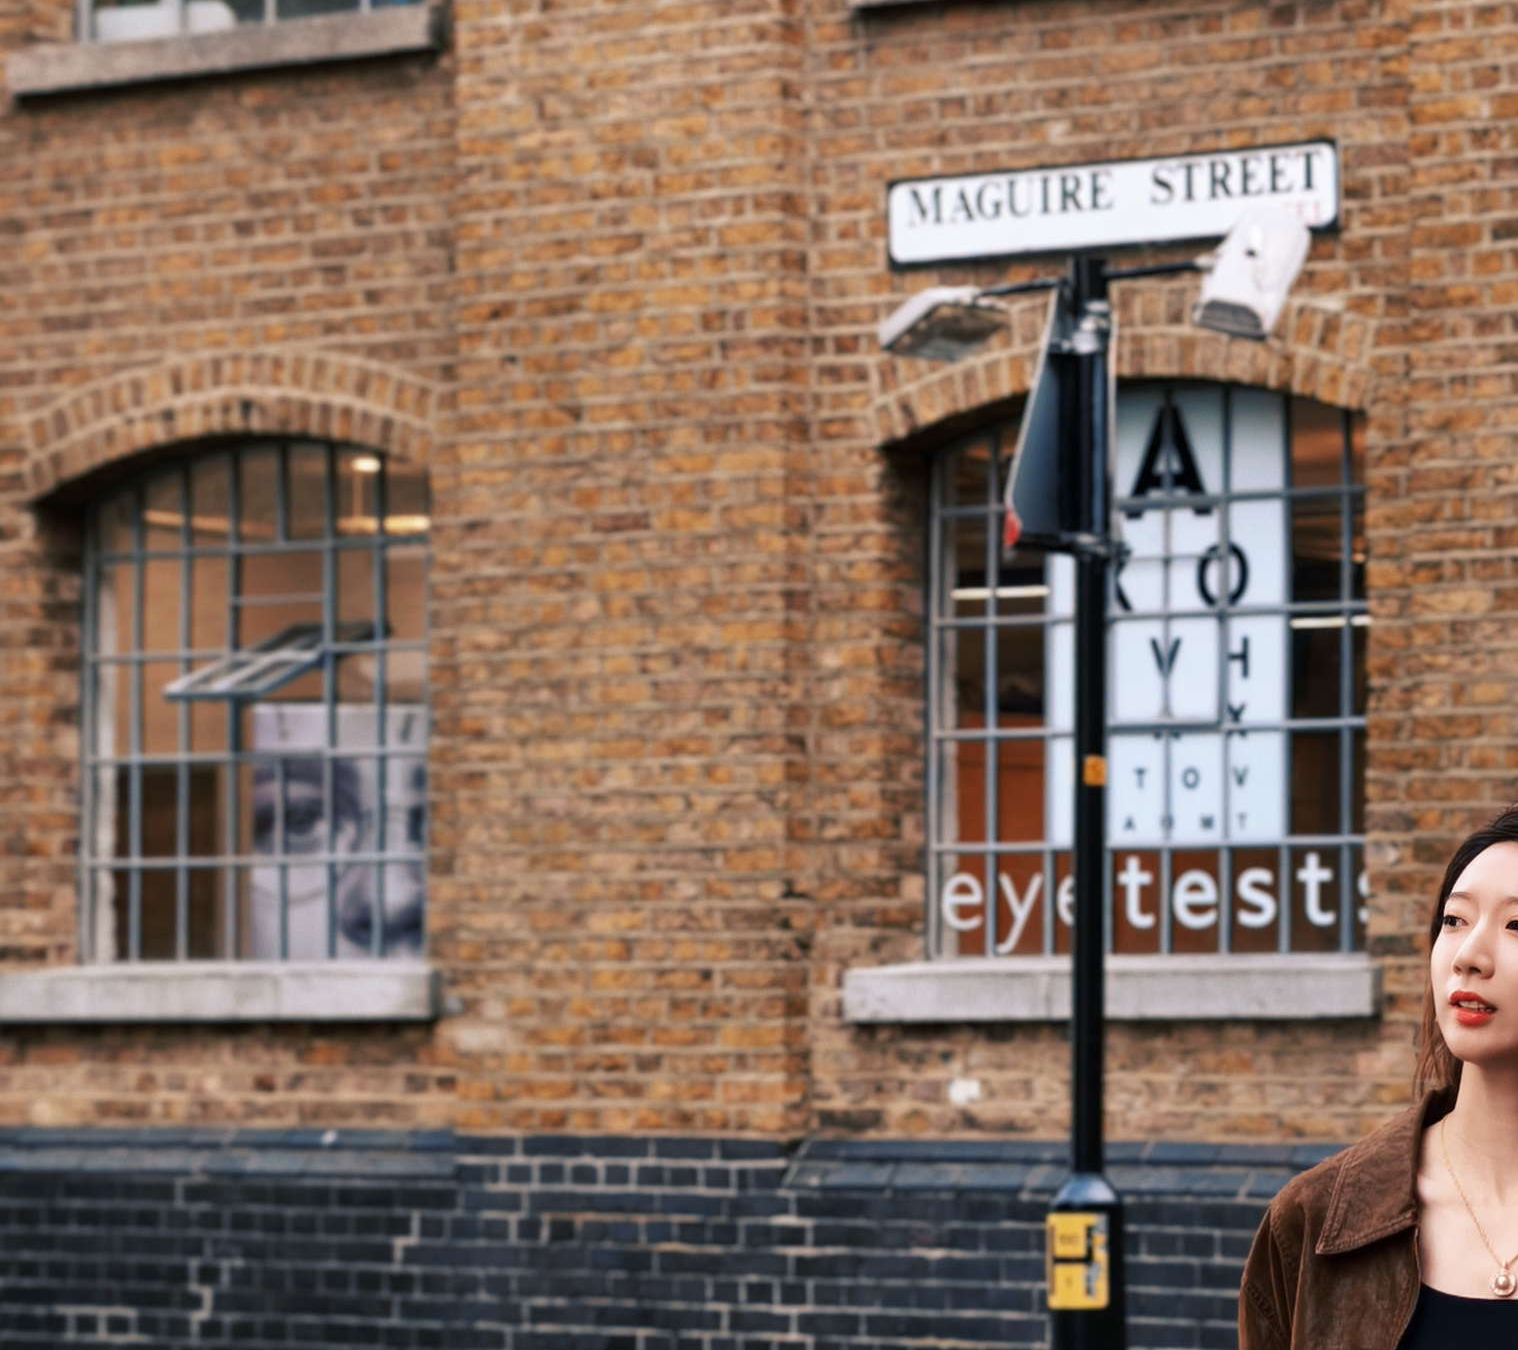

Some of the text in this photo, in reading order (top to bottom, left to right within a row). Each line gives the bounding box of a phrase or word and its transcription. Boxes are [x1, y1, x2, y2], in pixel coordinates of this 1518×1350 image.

[907, 151, 1324, 228] MAGUIRE STREET
[1127, 404, 1214, 518] A
[1117, 854, 1368, 929] test
